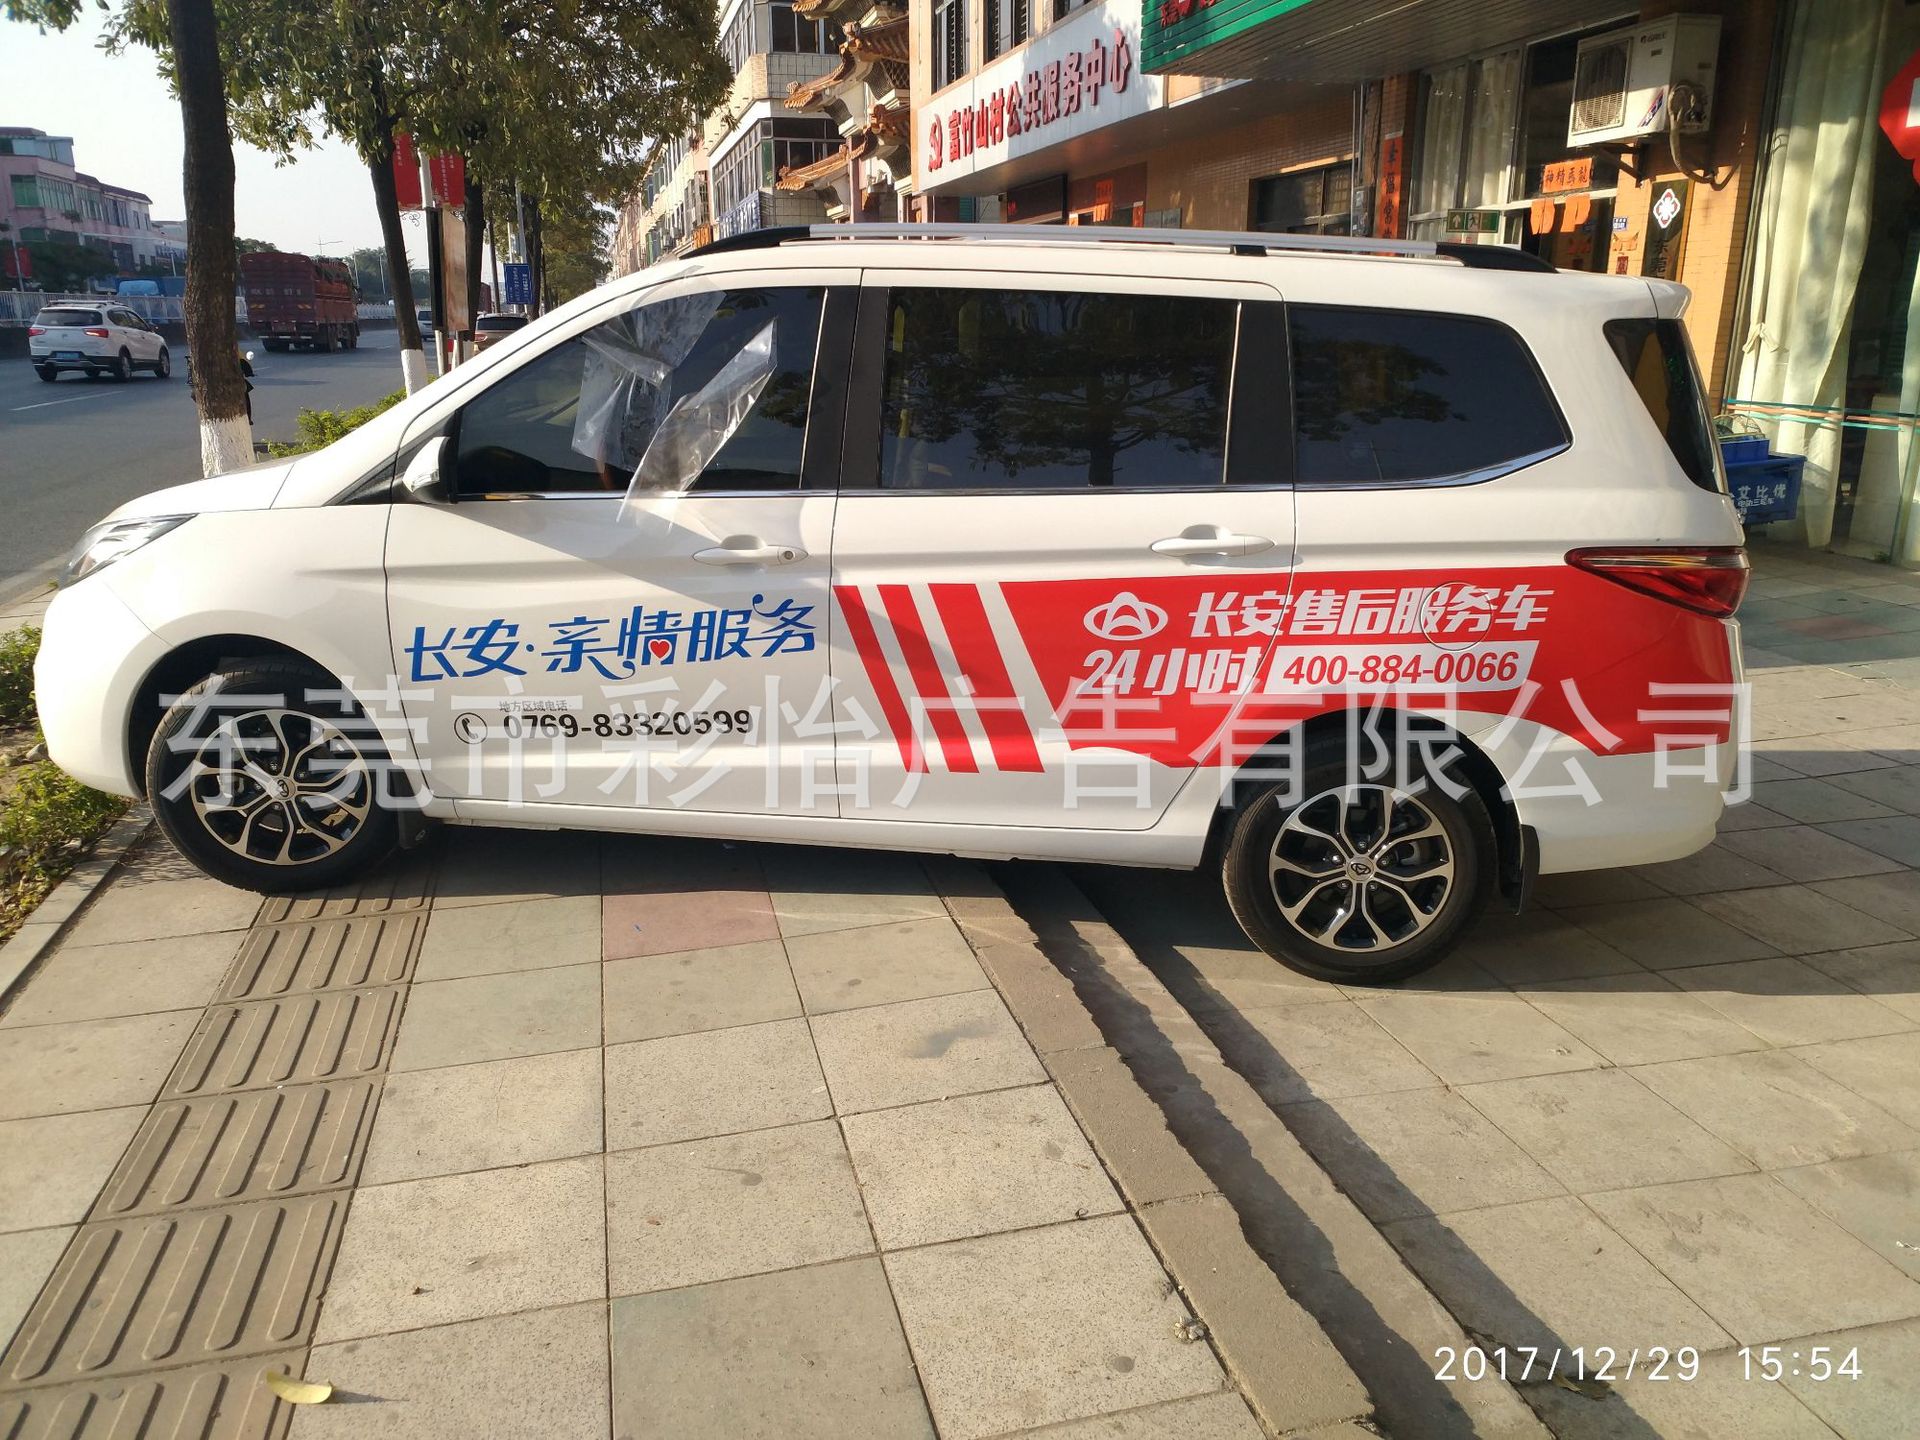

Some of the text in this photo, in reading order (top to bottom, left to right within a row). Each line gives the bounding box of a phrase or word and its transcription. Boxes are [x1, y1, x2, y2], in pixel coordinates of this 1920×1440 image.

[948, 27, 1132, 163] 富竹山村公共服务中心
[1650, 238, 1670, 279] 东莞
[1188, 584, 1555, 638] 长安售后服务车
[1075, 645, 1263, 696] 24小时
[1283, 650, 1520, 686] 400-884-0066
[503, 709, 754, 740] 0769-83320599
